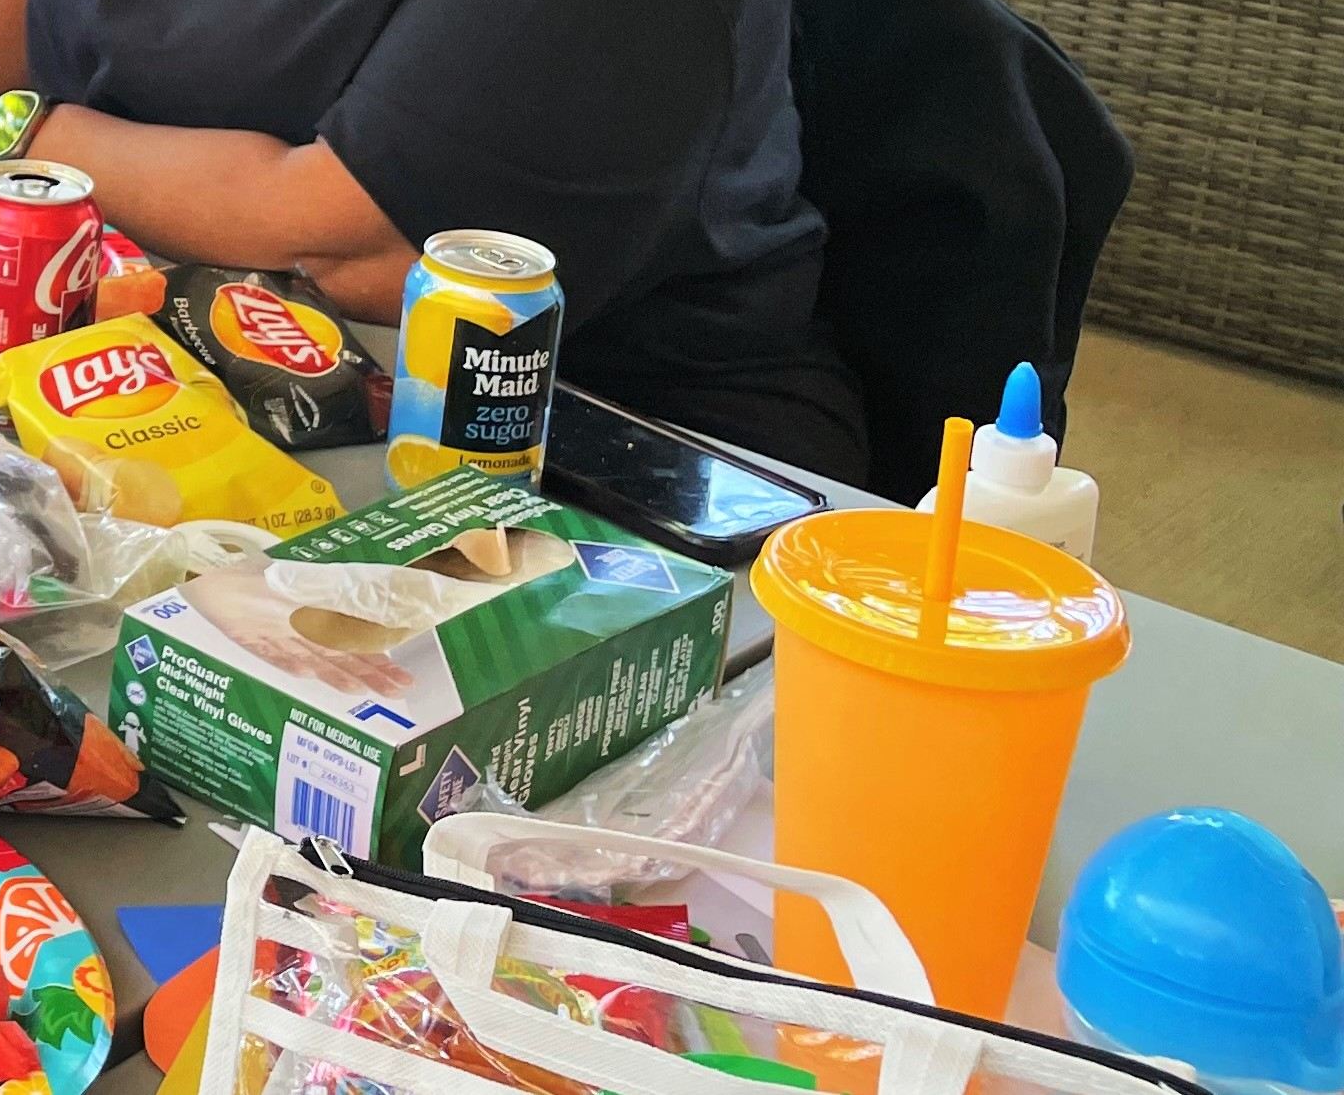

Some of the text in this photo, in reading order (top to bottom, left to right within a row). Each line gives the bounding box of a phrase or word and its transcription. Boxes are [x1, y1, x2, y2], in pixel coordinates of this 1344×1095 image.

[173, 296, 216, 365] Barbecue
[229, 287, 322, 369] Lay's
[50, 343, 176, 412] Lay's
[462, 347, 550, 374] Minute
[472, 373, 541, 397] Maid
[104, 413, 202, 451] Classic
[464, 420, 534, 446] sugar
[475, 406, 529, 422] zero
[386, 522, 449, 551] Gloves
[443, 504, 490, 527] Vinyl
[153, 601, 188, 620] 100
[711, 600, 725, 635] 100
[158, 660, 226, 703] Mid-Weight
[635, 671, 649, 715] CLEAR
[662, 637, 681, 718] LATEX FREE
[156, 676, 189, 703] Clear
[192, 694, 225, 720] Vinyl
[226, 712, 273, 745] Gloves
[513, 697, 531, 755] Vinyl
[573, 696, 587, 746] LARGE
[601, 658, 622, 756] POWDER FREE
[289, 707, 382, 762] NOT FOR MEDICAL USE
[286, 752, 300, 766] LOT
[399, 743, 427, 777] L
[518, 733, 539, 806] Gloves
[434, 769, 453, 819] SAFETY
